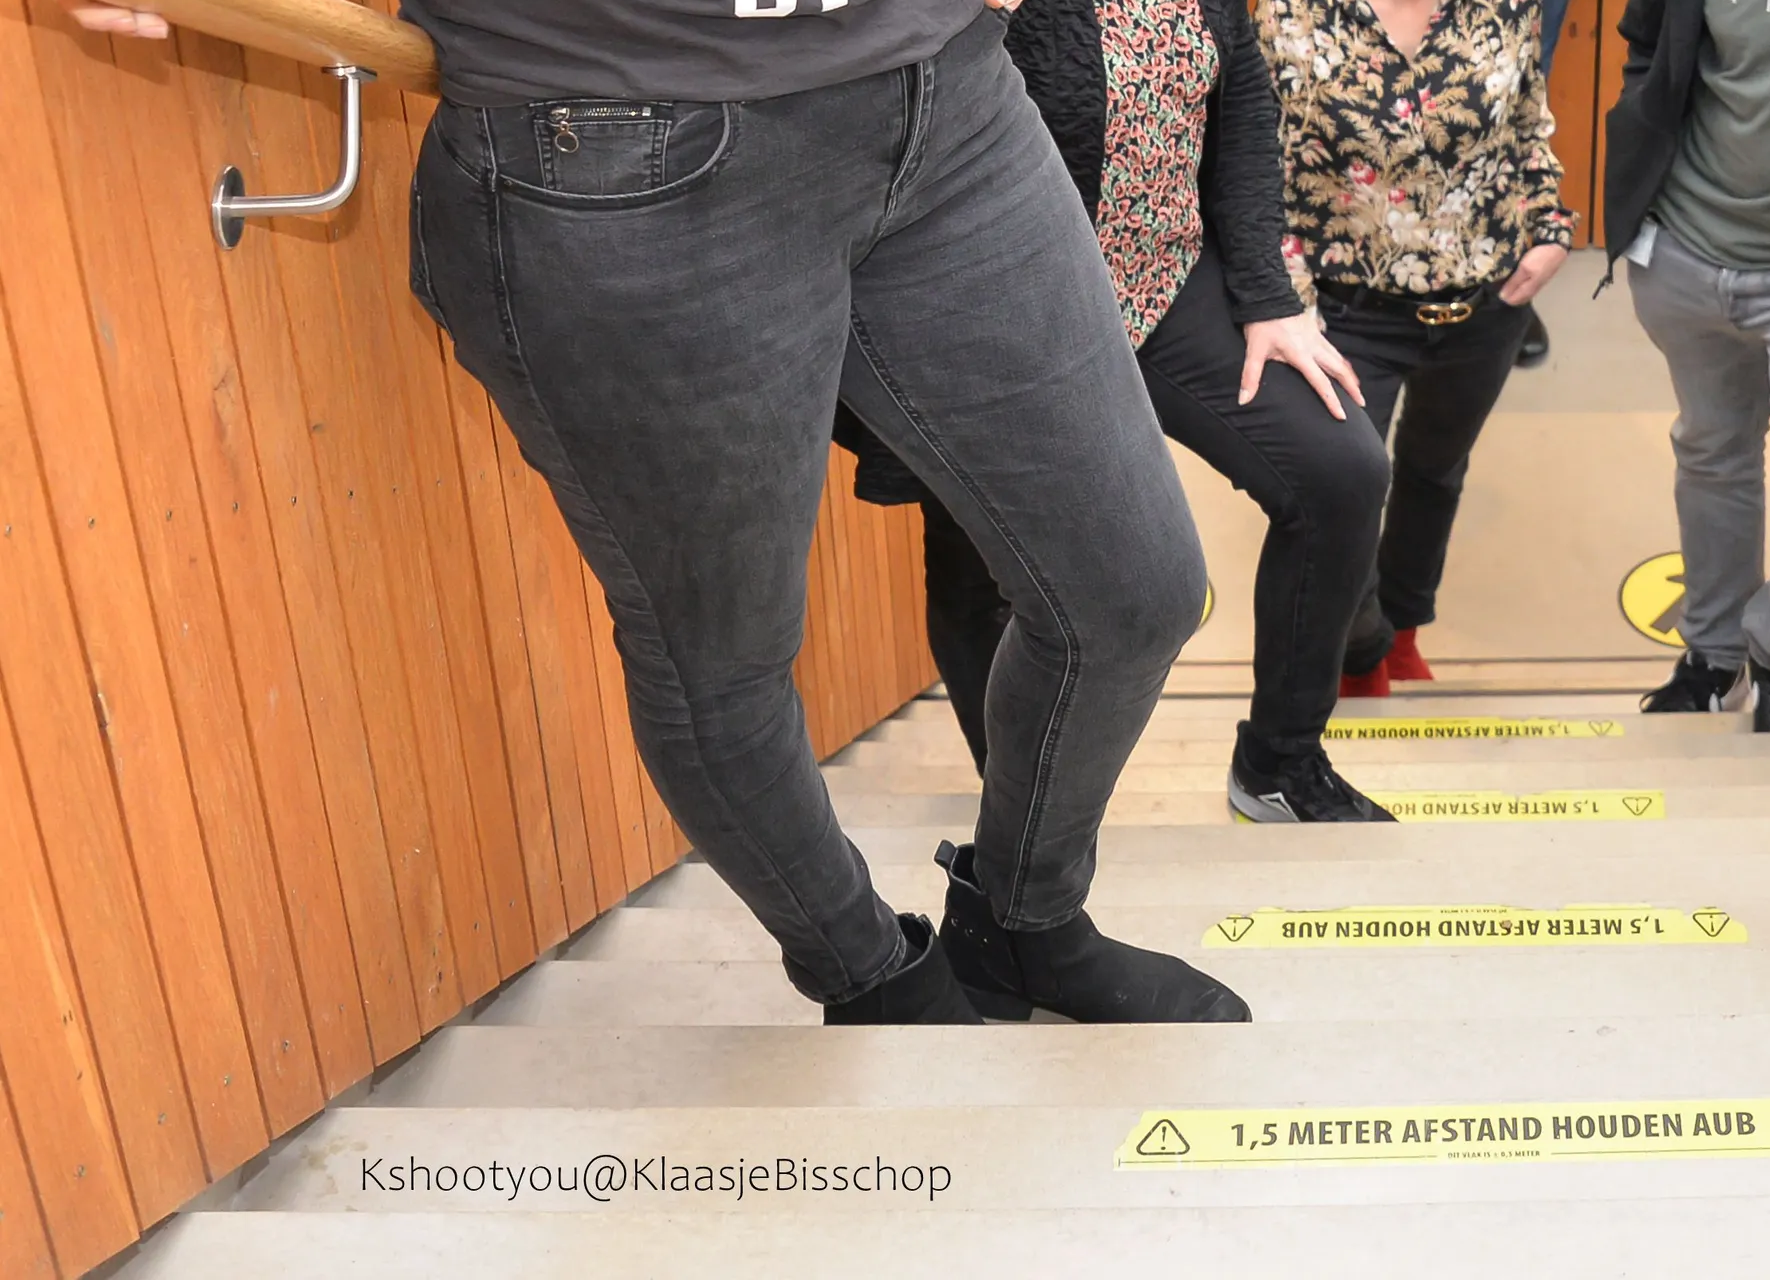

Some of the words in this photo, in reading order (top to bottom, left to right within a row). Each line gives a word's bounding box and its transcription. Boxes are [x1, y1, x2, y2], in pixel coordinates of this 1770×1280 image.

[1358, 727, 1419, 739] HOUDEN
[1424, 726, 1489, 739] AFSTAND
[1494, 725, 1543, 737] METER
[1423, 802, 1502, 816] AFSTAND
[1508, 802, 1567, 815] METER
[1573, 801, 1599, 814] 1,5
[1282, 922, 1329, 938] AUB
[1336, 921, 1431, 938] HOUDEN
[1438, 920, 1540, 937] AFSTAND
[1547, 919, 1622, 936] METER
[1630, 916, 1664, 934] 1,5
[1231, 1123, 1278, 1150] 1,5
[1288, 1120, 1393, 1145] METER
[1402, 1117, 1543, 1143] AFSTAND
[1552, 1113, 1683, 1140] HOUDEN
[1692, 1112, 1756, 1136] AUB
